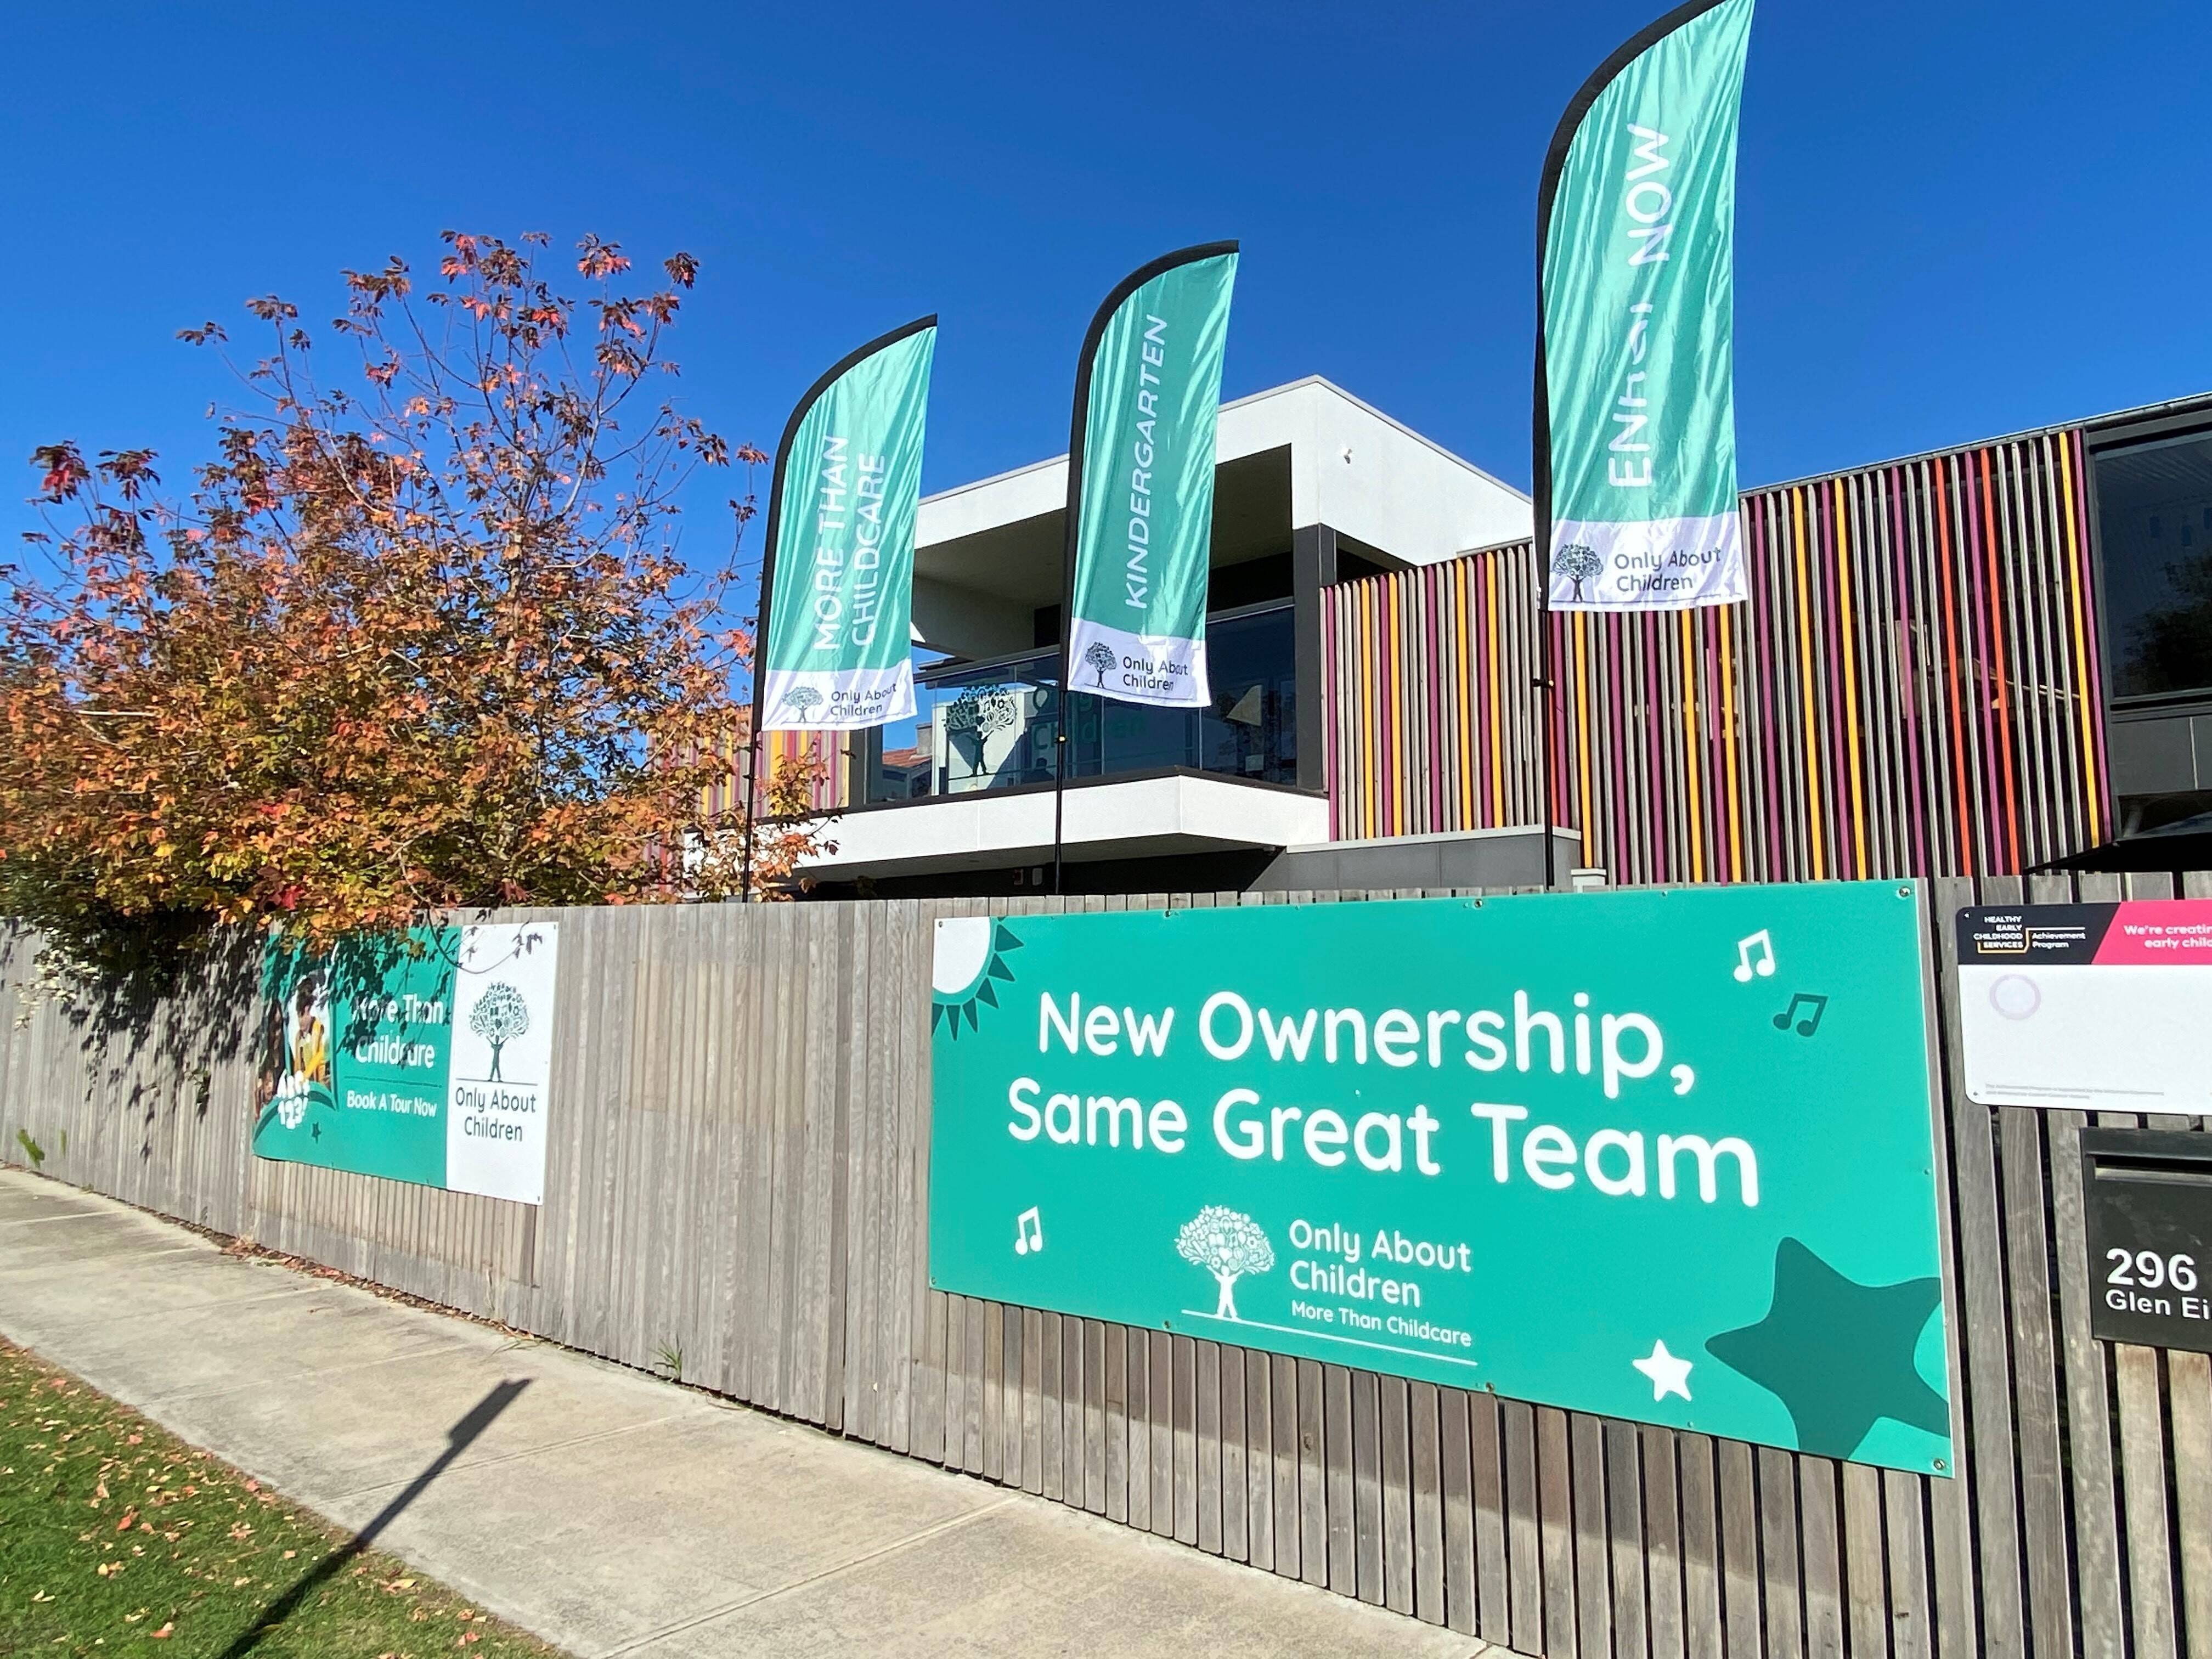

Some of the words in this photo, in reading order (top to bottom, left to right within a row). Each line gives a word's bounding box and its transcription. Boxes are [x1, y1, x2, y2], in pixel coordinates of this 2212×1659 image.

[1626, 123, 1673, 266] NOW
[1125, 314, 1167, 608] KINDERGARTEN
[817, 435, 848, 535] THAN
[851, 453, 885, 646] CHILDCARE
[1615, 551, 1662, 572] Only
[1667, 547, 1720, 567] About
[1617, 574, 1693, 592] Children
[814, 548, 844, 650] MORE
[1122, 656, 1153, 675] Only
[831, 690, 860, 703] Only
[865, 683, 896, 701] About
[1122, 674, 1173, 691] Children
[831, 704, 882, 716] Children
[2032, 941, 2069, 950] Program
[2124, 925, 2163, 935] We're
[2144, 938, 2180, 950] early
[403, 992, 443, 1024] Than
[1039, 991, 1175, 1057] New
[1199, 989, 1695, 1099] Ownership,
[347, 1090, 376, 1110] Book
[378, 1093, 387, 1111] A
[390, 1094, 414, 1114] Tour
[414, 1097, 437, 1118] Now
[455, 1087, 486, 1113] Only
[490, 1090, 536, 1113] About
[464, 1116, 522, 1142] Children
[1008, 1077, 1188, 1153] Same
[1213, 1088, 1441, 1176] Great
[1470, 1103, 1759, 1207] Team
[1289, 1219, 1360, 1263] Only
[1372, 1229, 1471, 1273] About
[1290, 1260, 1421, 1308] Children
[2106, 1248, 2198, 1292] 296
[2106, 1289, 2171, 1316] Glen
[2181, 1296, 2210, 1320] Ei
[1292, 1300, 1334, 1322] More
[1339, 1307, 1381, 1331] Than
[1387, 1316, 1472, 1347] Childcare
